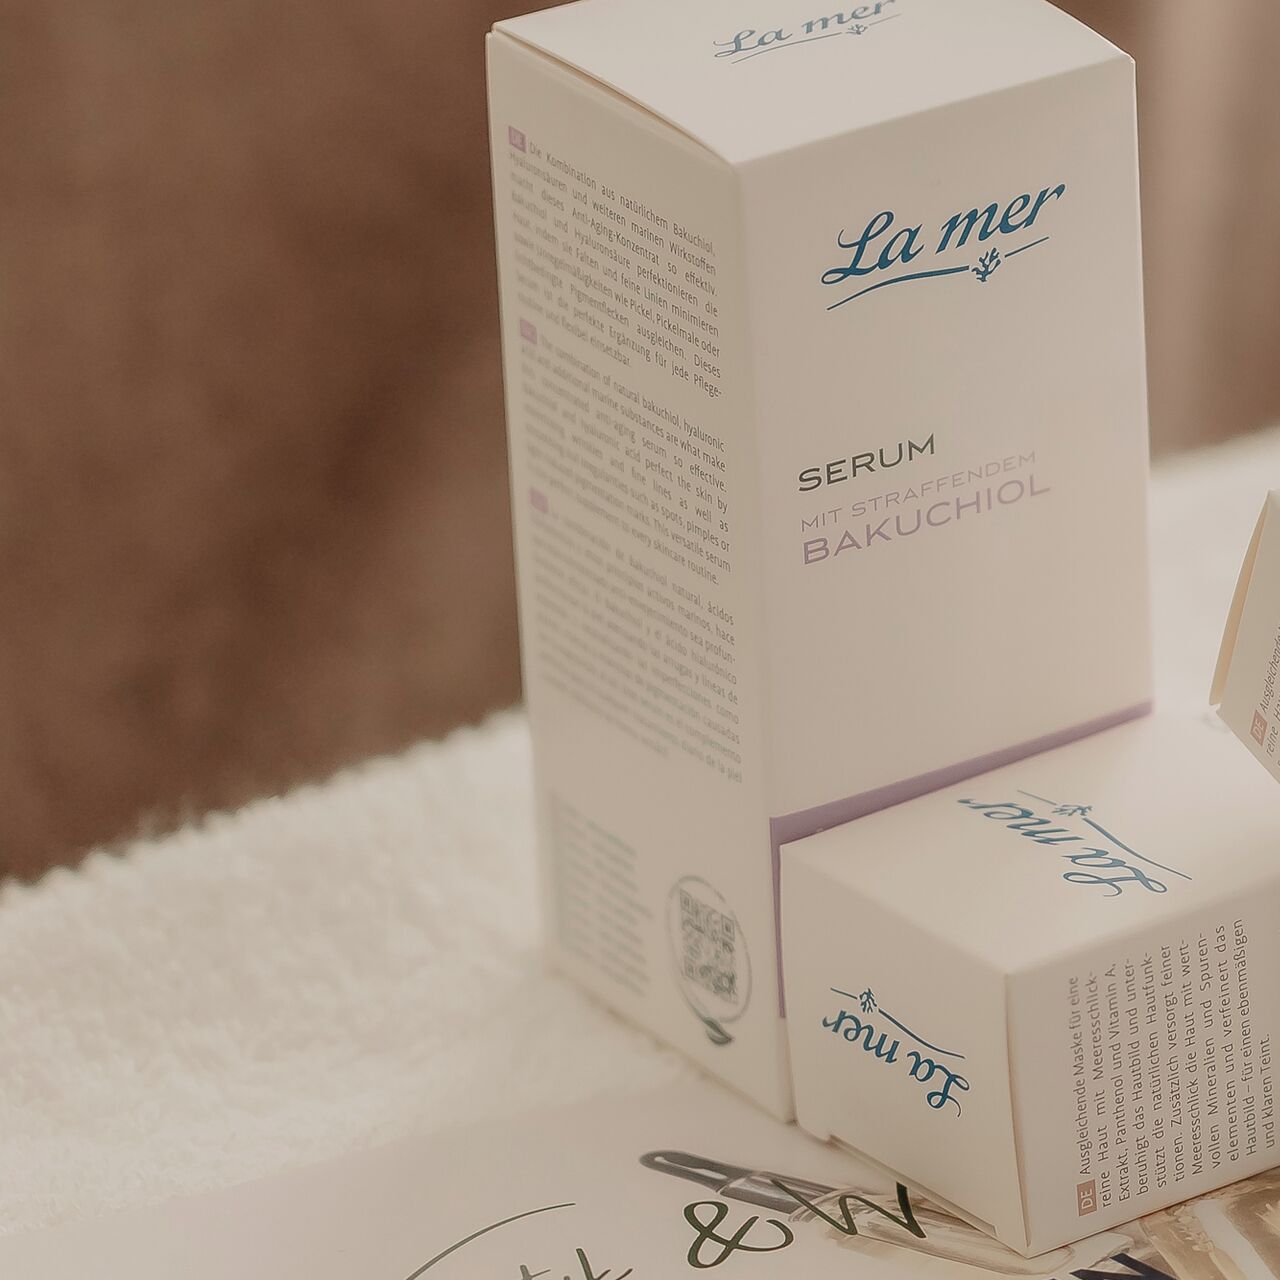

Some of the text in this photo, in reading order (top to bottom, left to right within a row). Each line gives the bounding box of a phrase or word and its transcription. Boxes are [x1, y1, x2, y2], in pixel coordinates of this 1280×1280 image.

[713, 28, 793, 58] La
[546, 151, 596, 190] Kombination
[619, 195, 668, 230] natürlichem
[672, 222, 715, 257] Bakuchiol,
[592, 200, 716, 276] weiteren marinen Wirkstoffen
[821, 183, 1066, 284] La mer
[571, 207, 659, 265] Anti-Aging-Konzentrat
[684, 271, 717, 297] effektiv.
[636, 265, 698, 306] perfektionieren
[671, 304, 719, 337] minimieren
[700, 340, 720, 358] oder
[693, 353, 720, 378] Dieses
[798, 433, 935, 492] SERUM
[801, 451, 1036, 532] MIT STRAFFENDEM
[804, 474, 1051, 565] BAKUCHIOL
[957, 798, 1168, 898] La mer
[1068, 1009, 1081, 1029] für
[1070, 975, 1080, 1006] eine
[1104, 982, 1119, 1040] Vitamin
[822, 1010, 970, 1118] La mer
[1069, 1031, 1084, 1076] Maske
[1108, 1042, 1122, 1070] und
[1124, 957, 1149, 1195] beruhigt das Hautbild und unter-
[1140, 952, 1167, 1188] stützt die natürlichen Hautfunk-
[1160, 945, 1185, 1182] tionen. Zusätzlich versorgt feiner
[1178, 938, 1202, 1174] Meeresschlick die Haut mit wert-
[1197, 932, 1221, 1169] vollen Mineralien und Spuren-
[1213, 925, 1239, 1161] elementen und verfeinert das
[1232, 919, 1256, 1156] Hautbild für einen ebenmäßigen
[1072, 1078, 1092, 1174] Ausgleichende
[1085, 971, 1111, 1207] reine Haut mit Meeresschlick-
[1110, 1074, 1126, 1145] Panthenol
[1258, 1033, 1275, 1149] und klaren Teint.
[1115, 1147, 1130, 1201] Extrakt,
[684, 1201, 794, 1269] &
